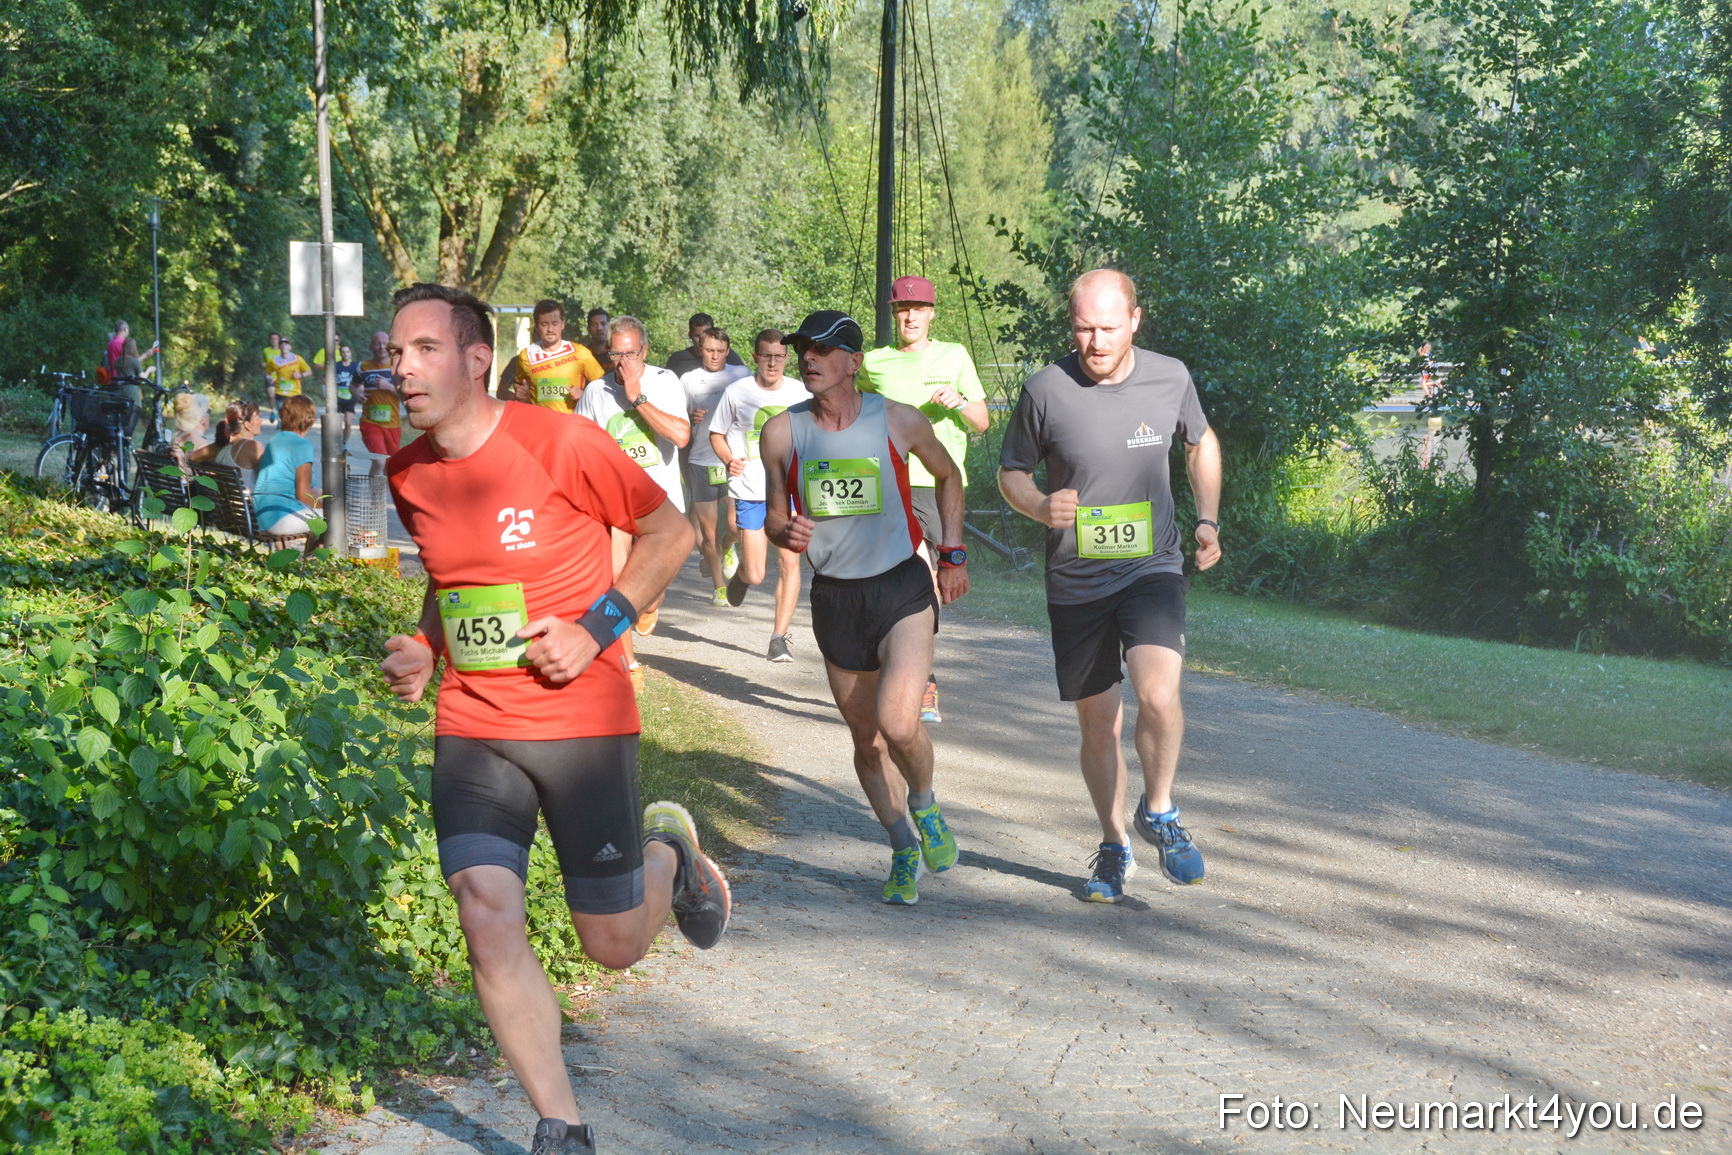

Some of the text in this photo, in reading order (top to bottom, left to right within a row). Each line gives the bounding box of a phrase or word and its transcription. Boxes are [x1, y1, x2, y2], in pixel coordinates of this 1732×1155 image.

[531, 364, 552, 374] MAX
[541, 385, 564, 394] 1330
[1127, 434, 1163, 446] BURKHARDT
[623, 445, 647, 459] 39
[820, 479, 864, 500] 932
[497, 507, 534, 544] 25
[1093, 523, 1136, 544] 319
[456, 616, 505, 647] 453
[460, 646, 508, 657] Fuchs Michael
[592, 852, 623, 862] adidas
